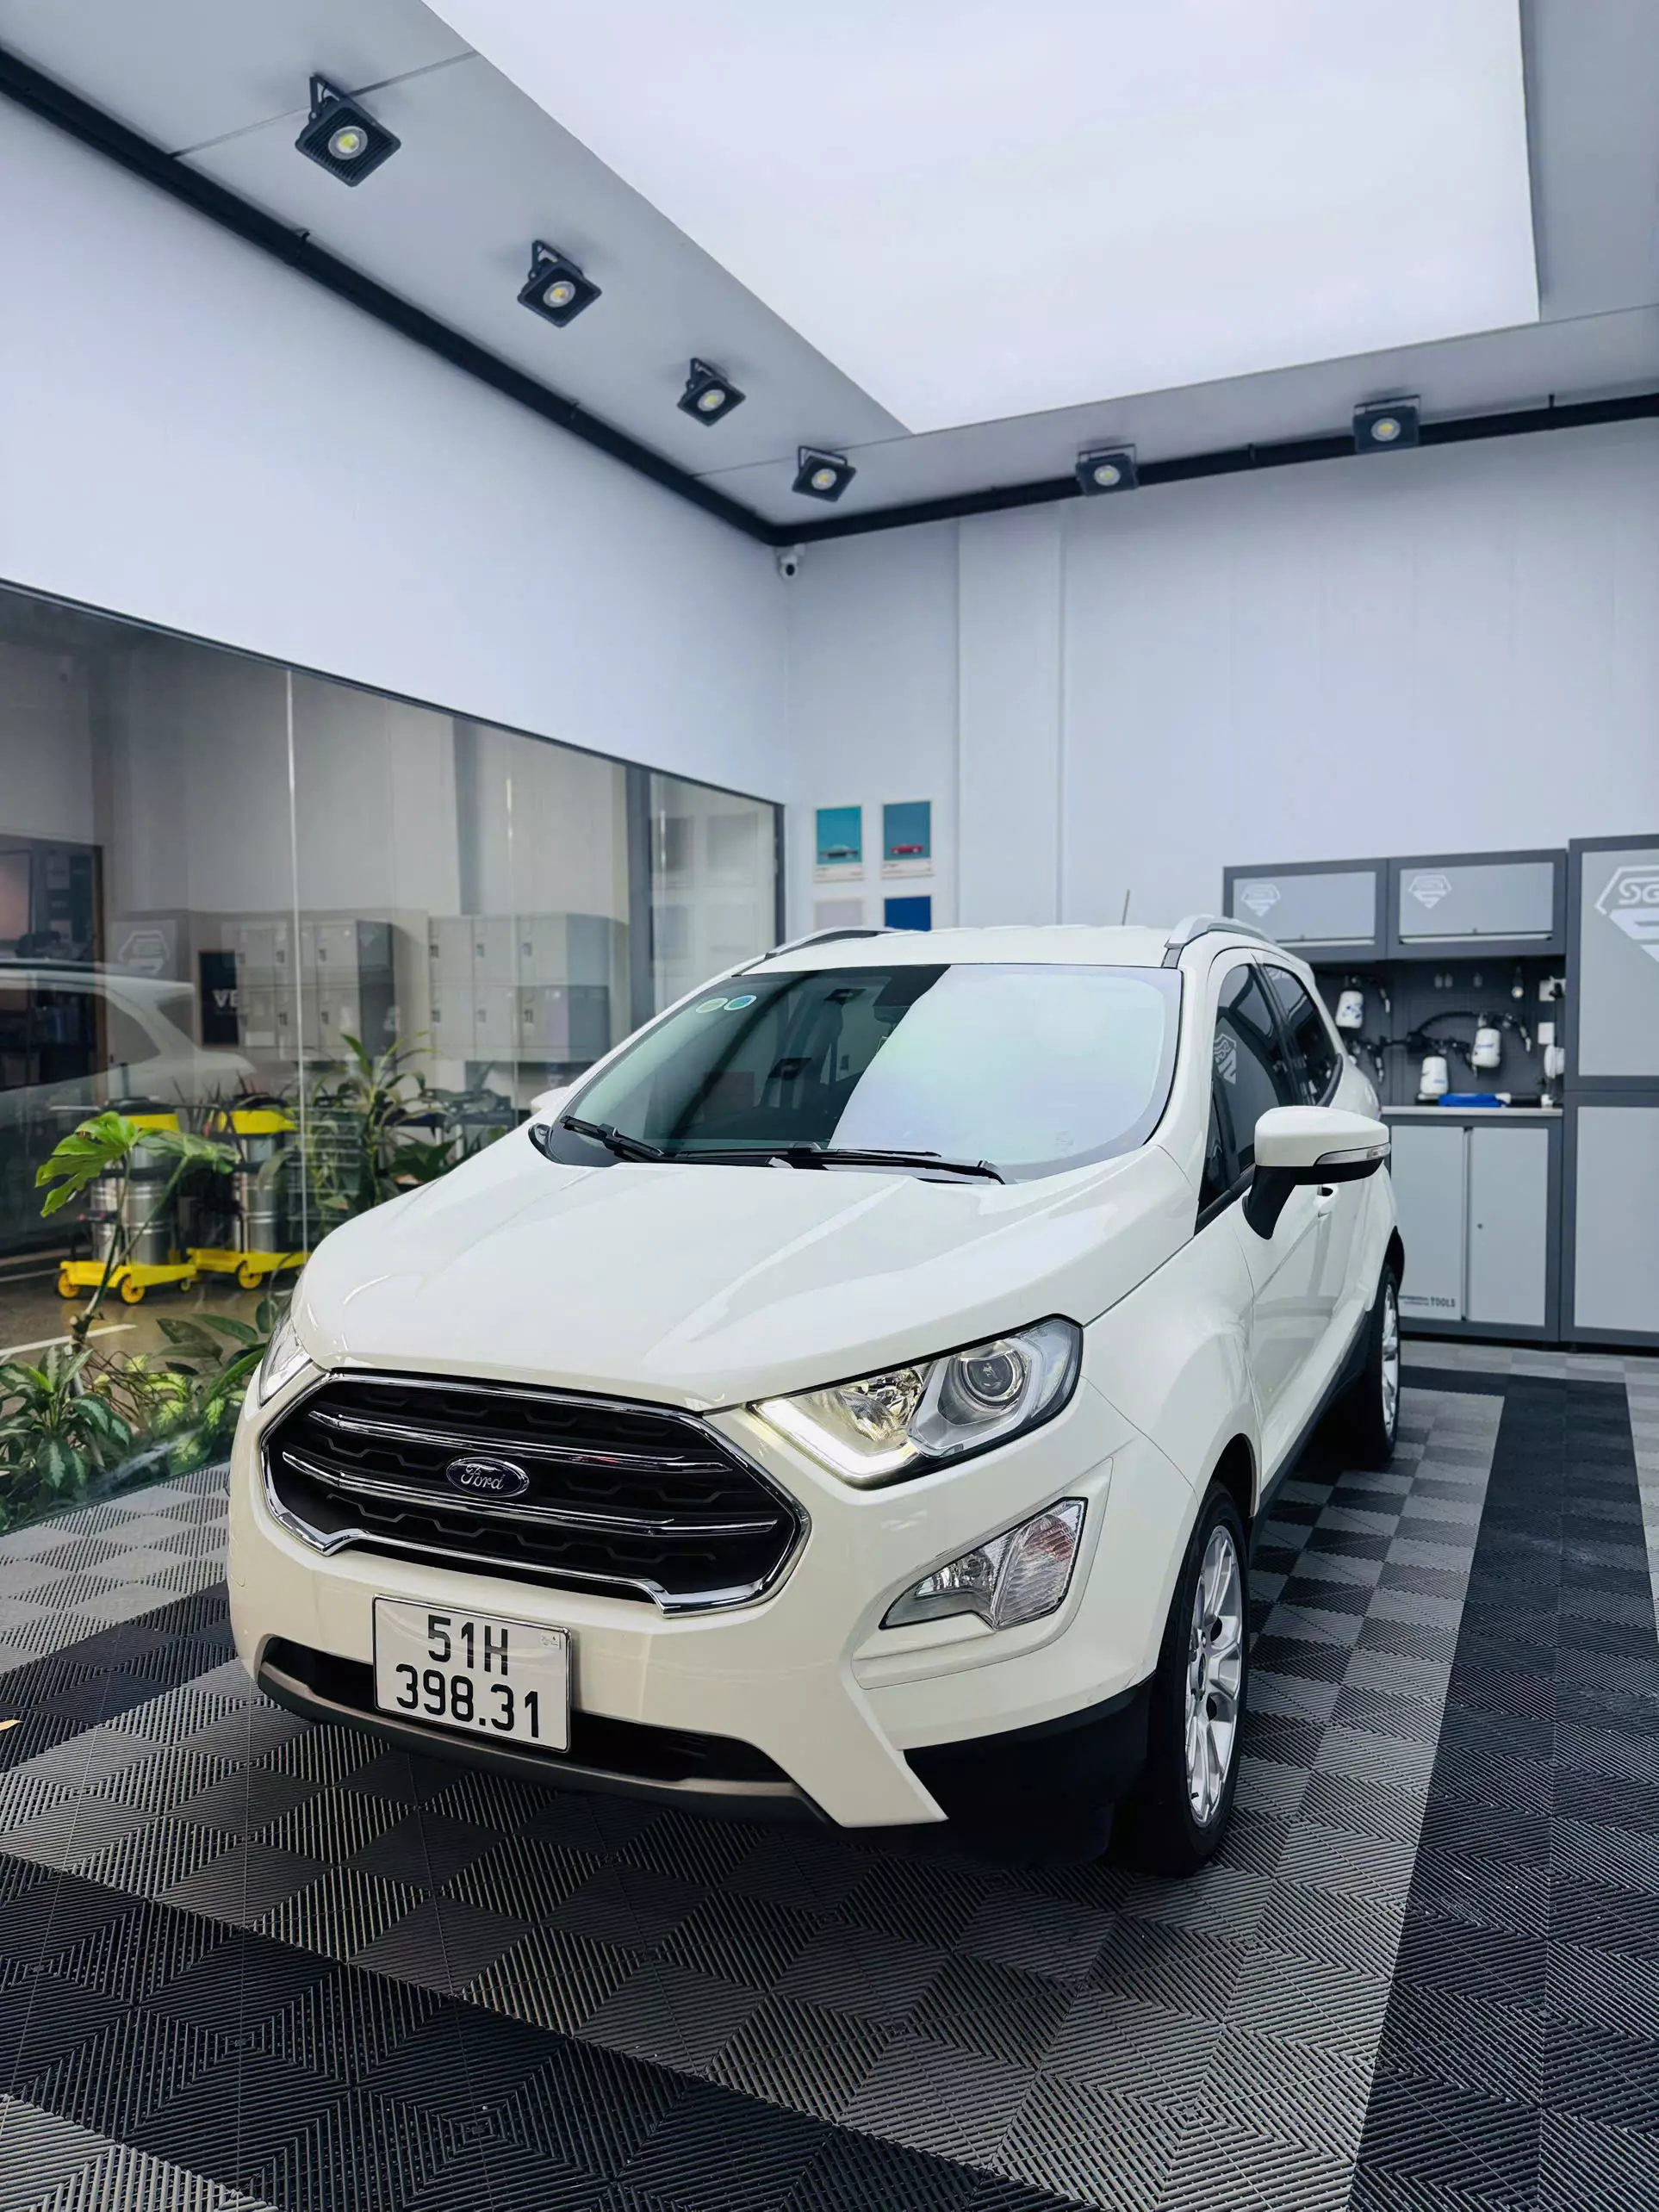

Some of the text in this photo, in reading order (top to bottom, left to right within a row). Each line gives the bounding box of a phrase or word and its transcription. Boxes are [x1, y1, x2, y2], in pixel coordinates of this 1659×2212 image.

[1431, 1296, 1455, 1308] TOOLS
[461, 1463, 506, 1490] Ford
[428, 1614, 508, 1676] 51H
[396, 1663, 539, 1738] 398.31
